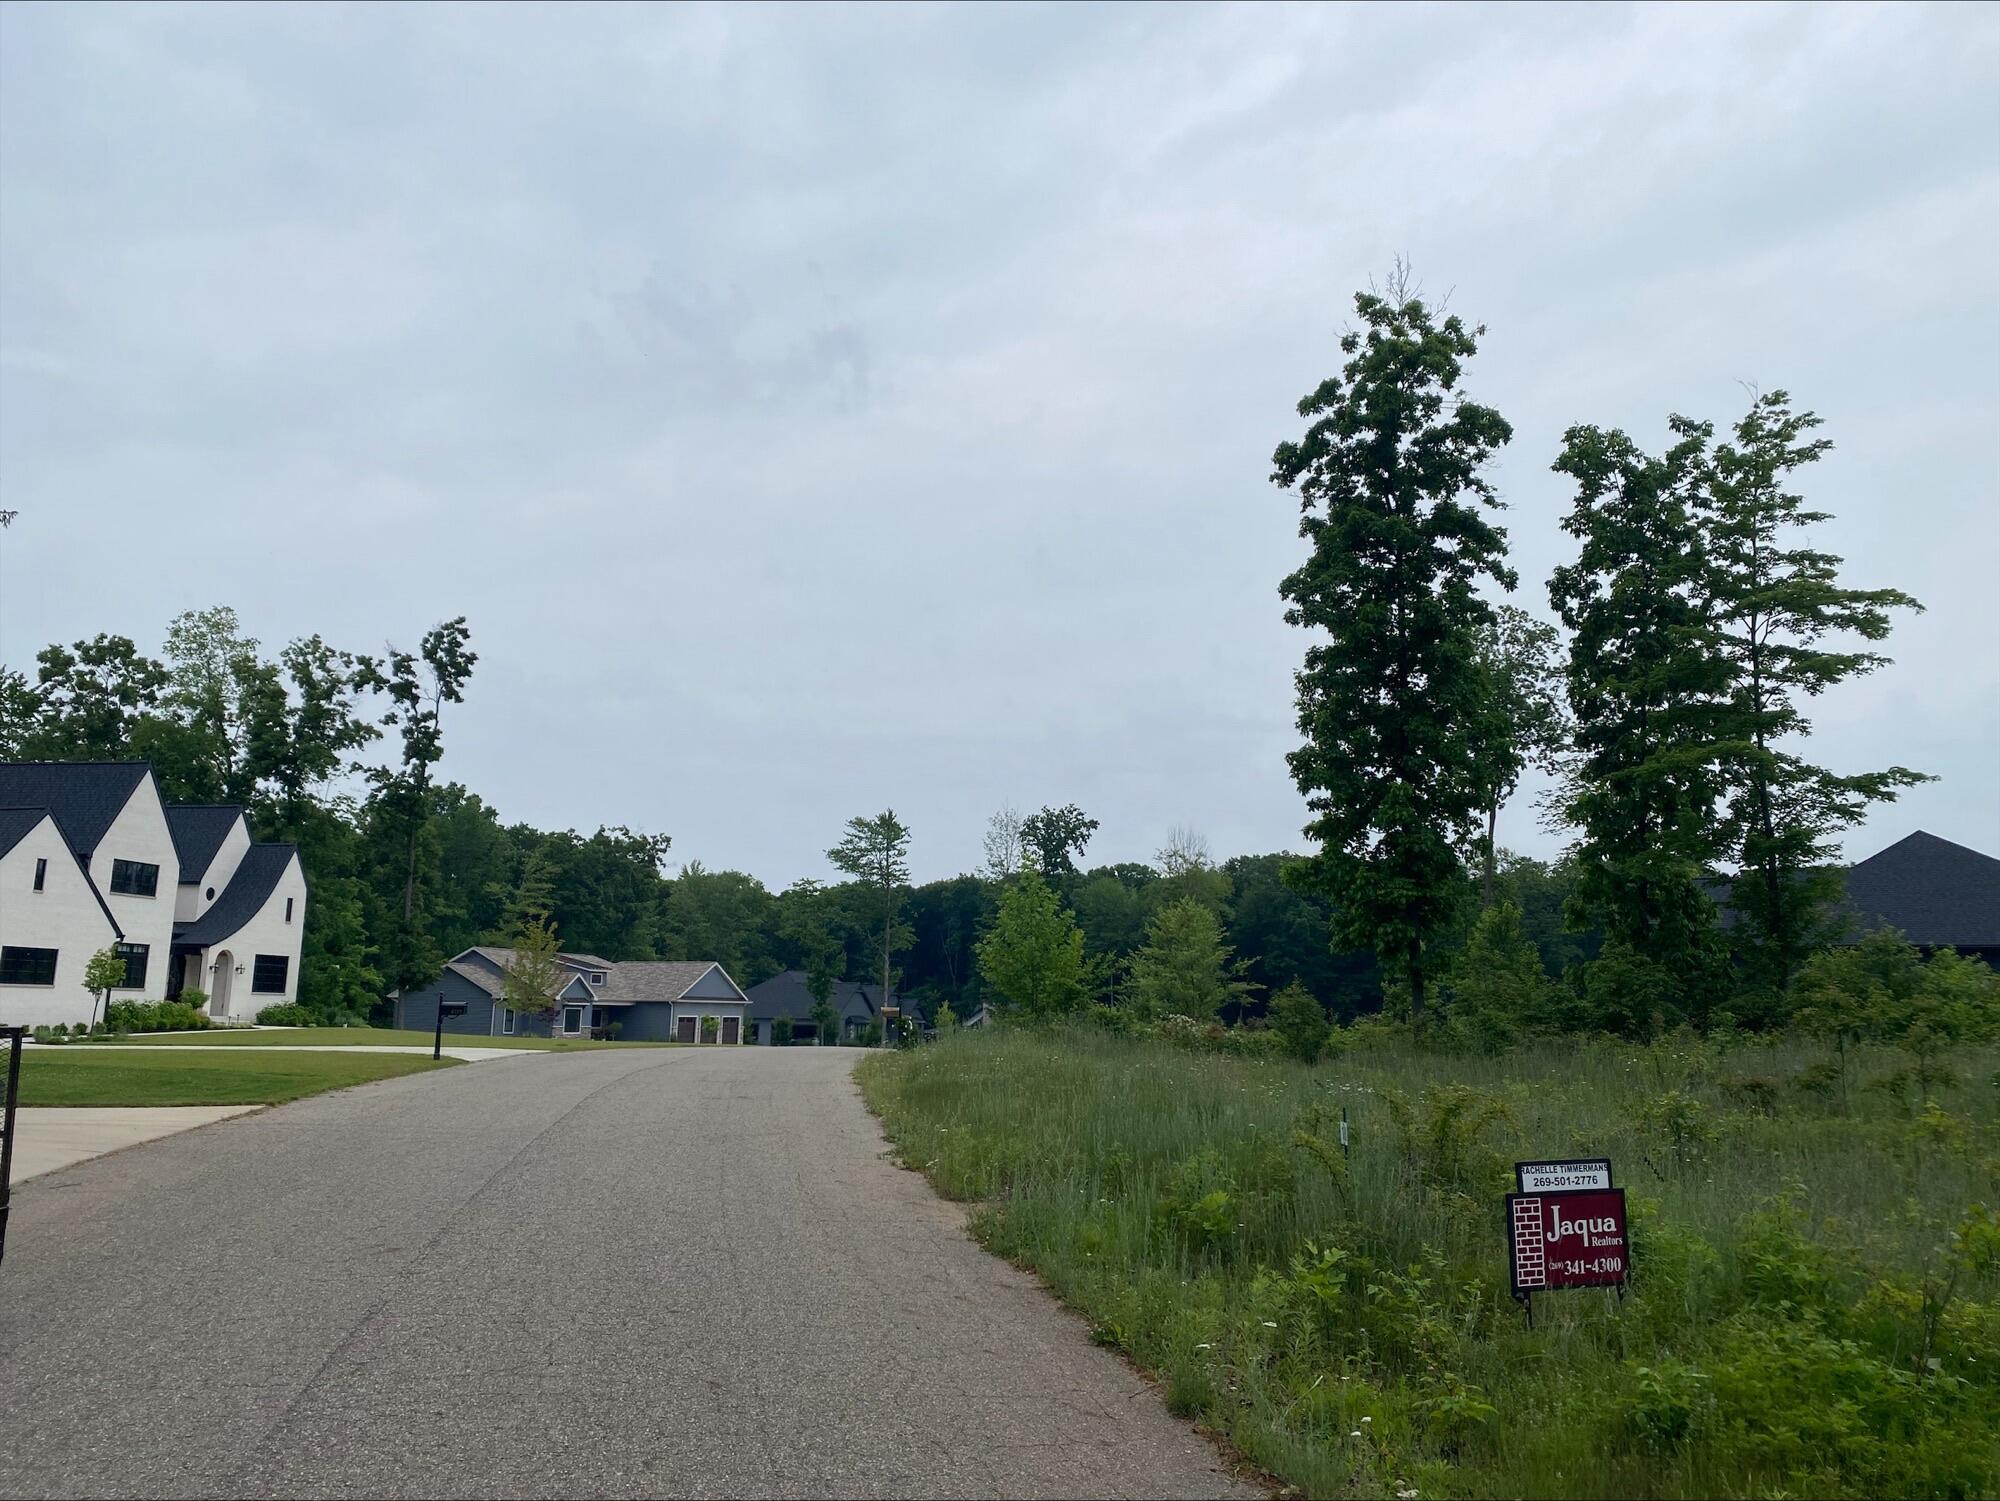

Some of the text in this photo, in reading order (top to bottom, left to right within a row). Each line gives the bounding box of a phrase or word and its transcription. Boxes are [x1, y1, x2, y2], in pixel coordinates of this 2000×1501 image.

[1560, 1163, 1608, 1173] TIMMERMANS
[1533, 1175, 1598, 1187] 269-501-2776
[1546, 1205, 1617, 1247] Jaqua
[1591, 1236, 1623, 1247] Realtors
[1564, 1257, 1621, 1275] 341-4300
